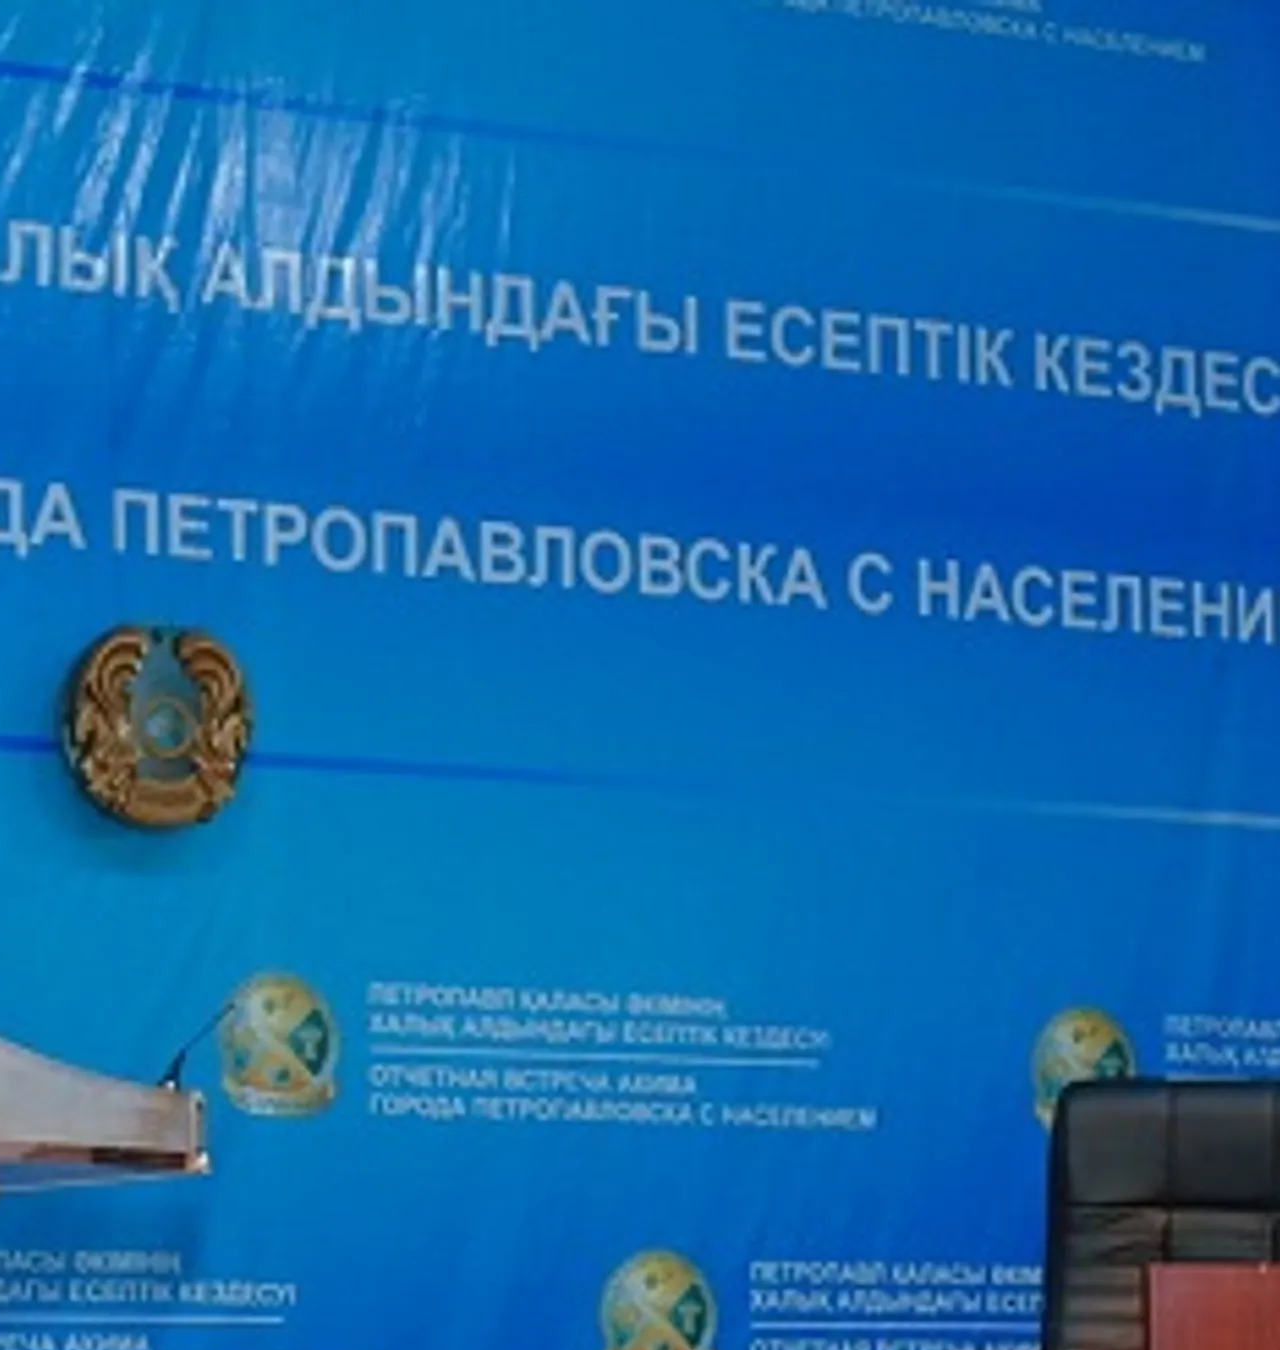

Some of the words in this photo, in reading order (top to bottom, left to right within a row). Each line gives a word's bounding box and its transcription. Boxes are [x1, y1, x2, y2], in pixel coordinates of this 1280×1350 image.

[201, 242, 699, 352] АЛДЫНДАҒЫ
[725, 299, 1013, 388] ЕСЕПТІК
[113, 488, 826, 609] ПЕТРОПАВЛОВСКА
[848, 552, 893, 615] С
